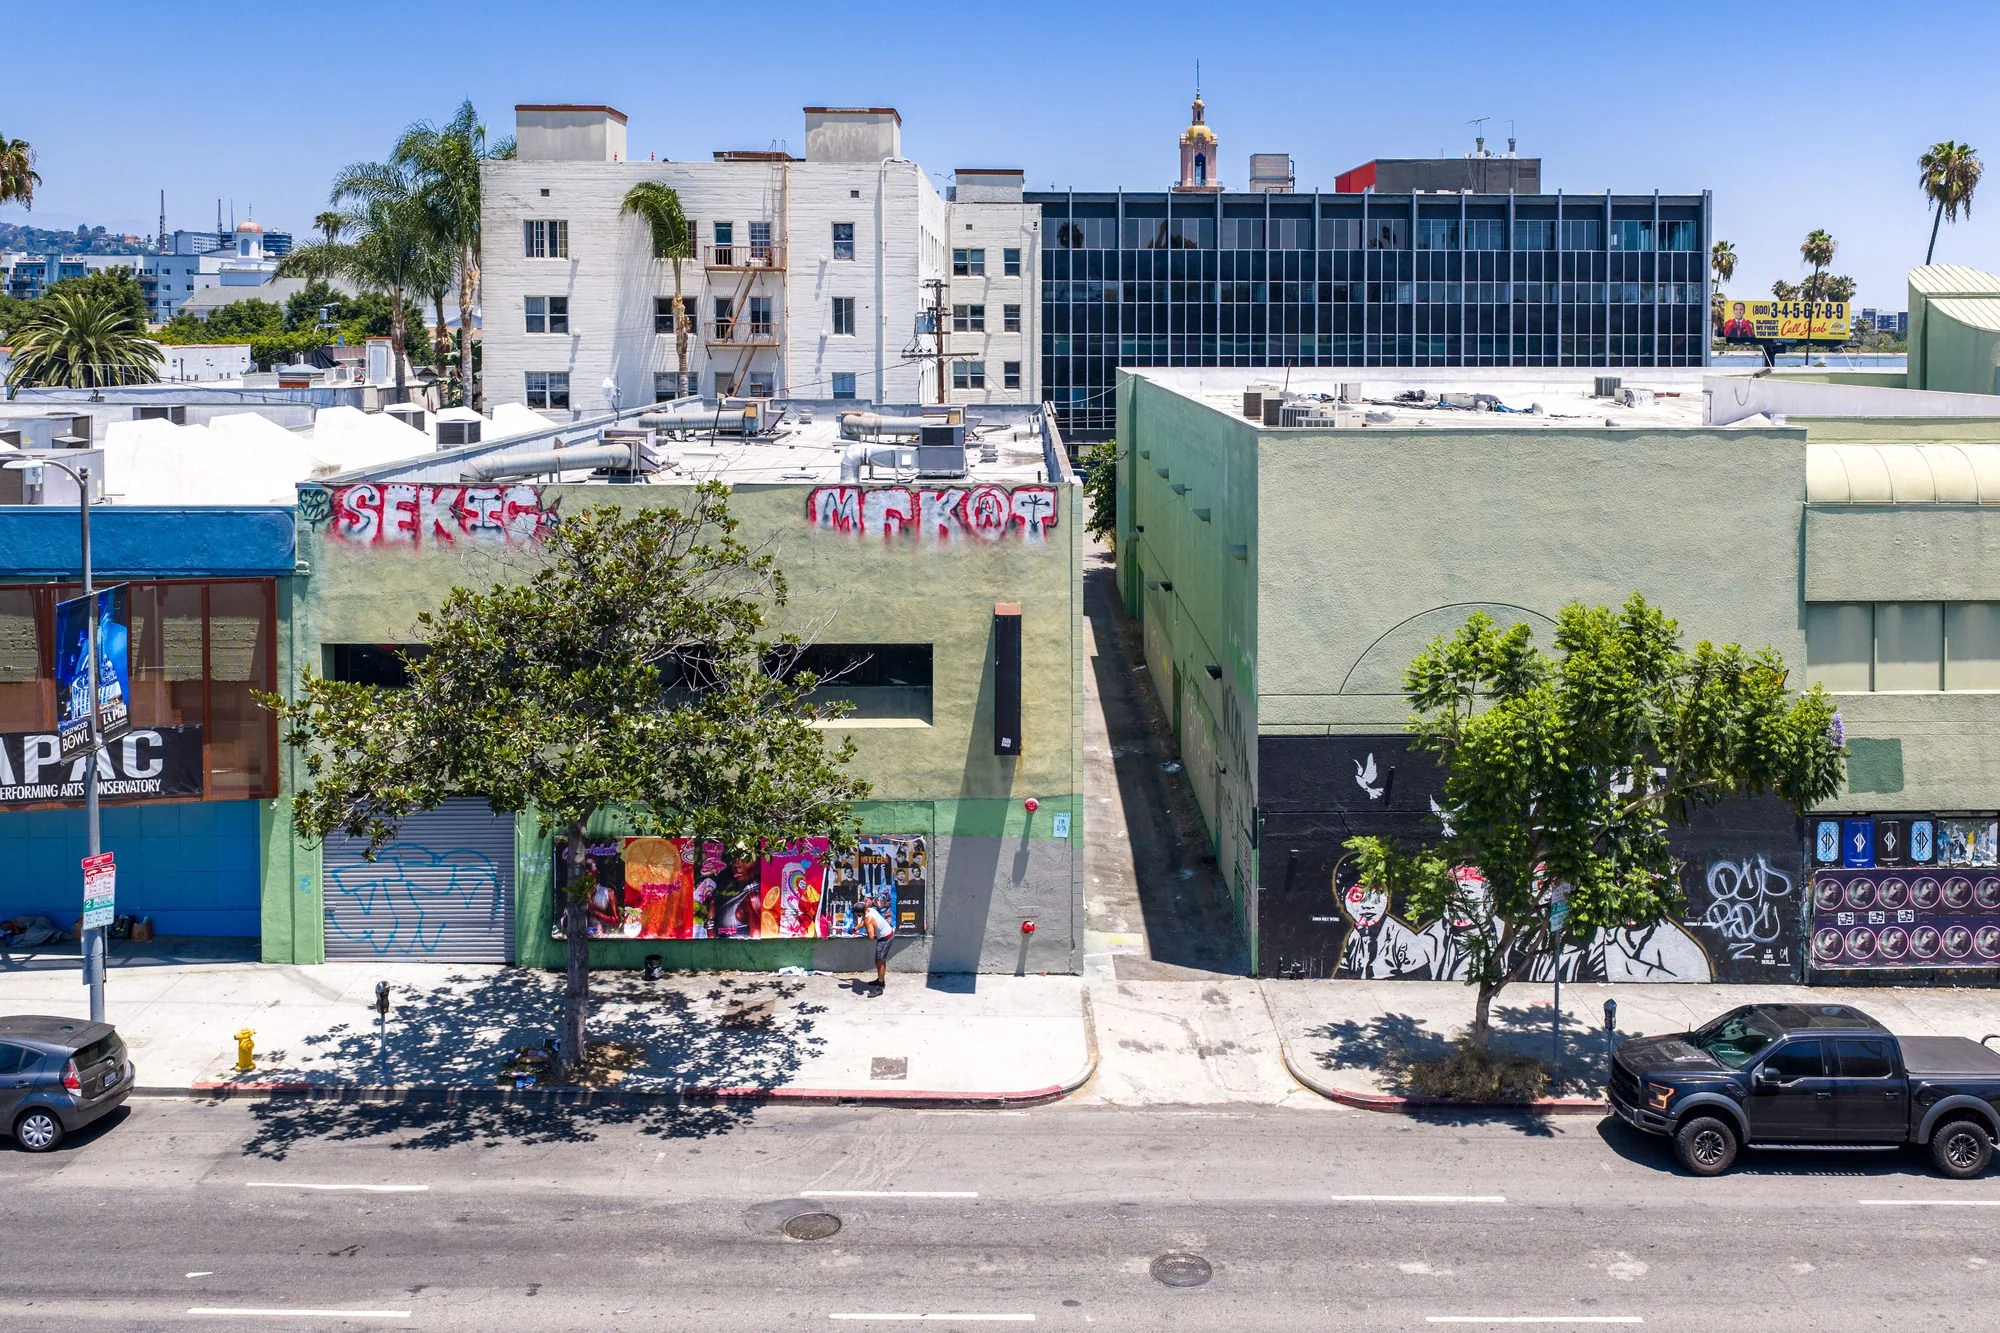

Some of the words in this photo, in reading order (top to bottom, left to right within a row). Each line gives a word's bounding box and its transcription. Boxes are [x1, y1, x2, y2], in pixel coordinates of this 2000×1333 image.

[1753, 304, 1770, 316] (800)
[1771, 302, 1844, 319] 3-4-5-6-7-8-9
[1781, 320, 1801, 336] Call
[103, 713, 113, 726] LA
[112, 704, 127, 721] Phil
[61, 721, 88, 738] HOLLYWOOD
[62, 729, 90, 752] BOWL
[60, 783, 84, 797] ARTS
[860, 856, 875, 864] NEXT
[876, 856, 889, 864] GEN
[85, 874, 95, 885] NO
[85, 900, 92, 909] 2
